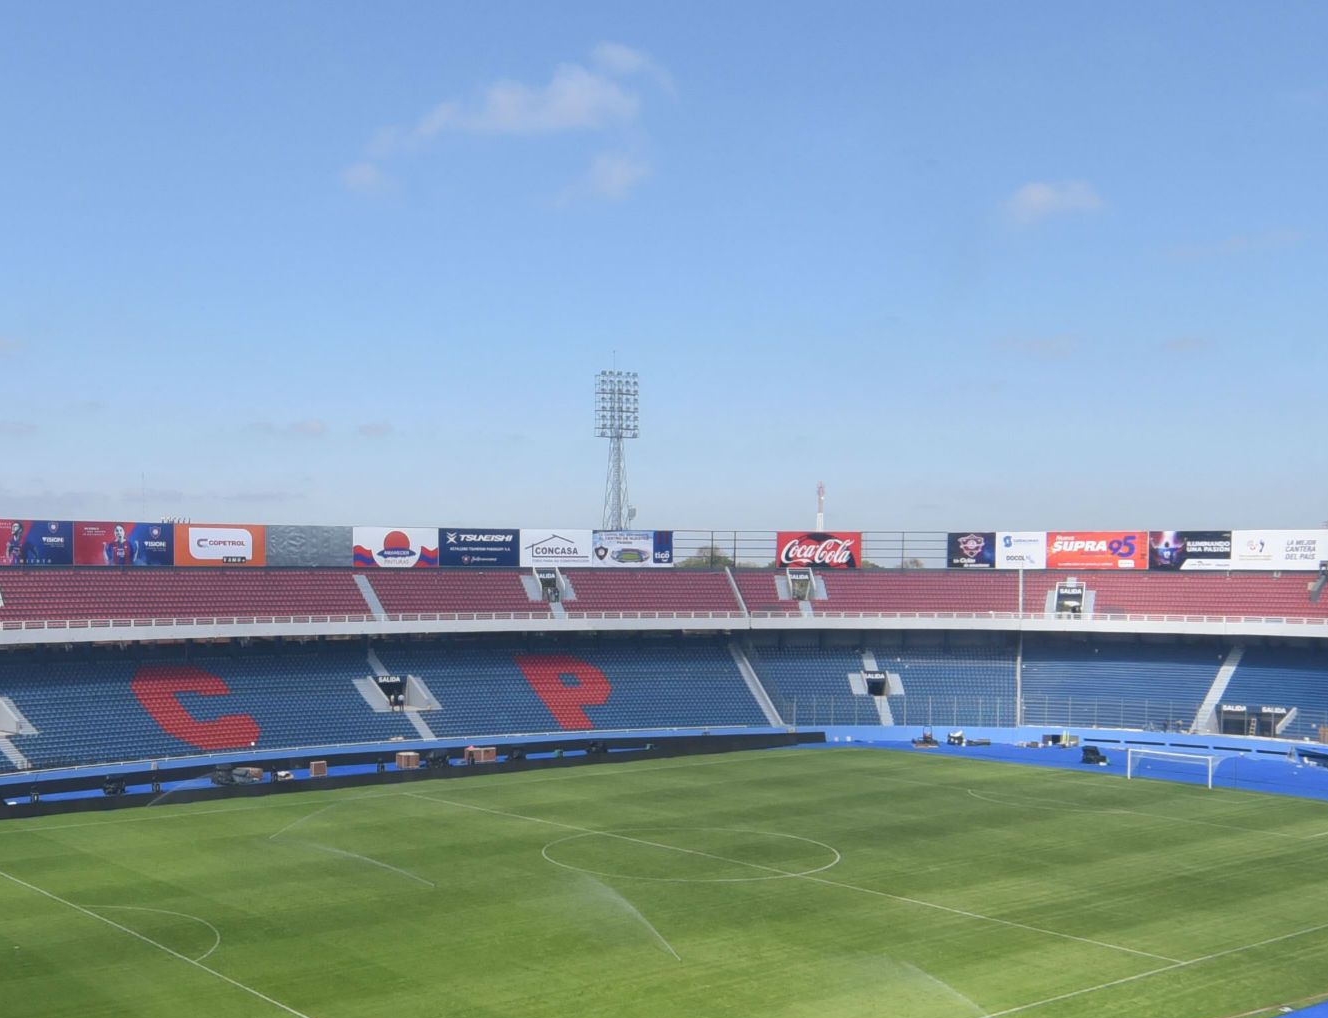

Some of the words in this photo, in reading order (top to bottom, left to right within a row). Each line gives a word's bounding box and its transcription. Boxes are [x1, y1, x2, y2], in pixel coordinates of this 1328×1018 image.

[459, 534, 513, 542] TSUNEISHI
[1053, 540, 1108, 552] SUPRA
[1108, 535, 1136, 558] 95
[535, 547, 578, 555] CONCASA
[513, 655, 612, 729] P
[1261, 706, 1287, 714] SALIDA
